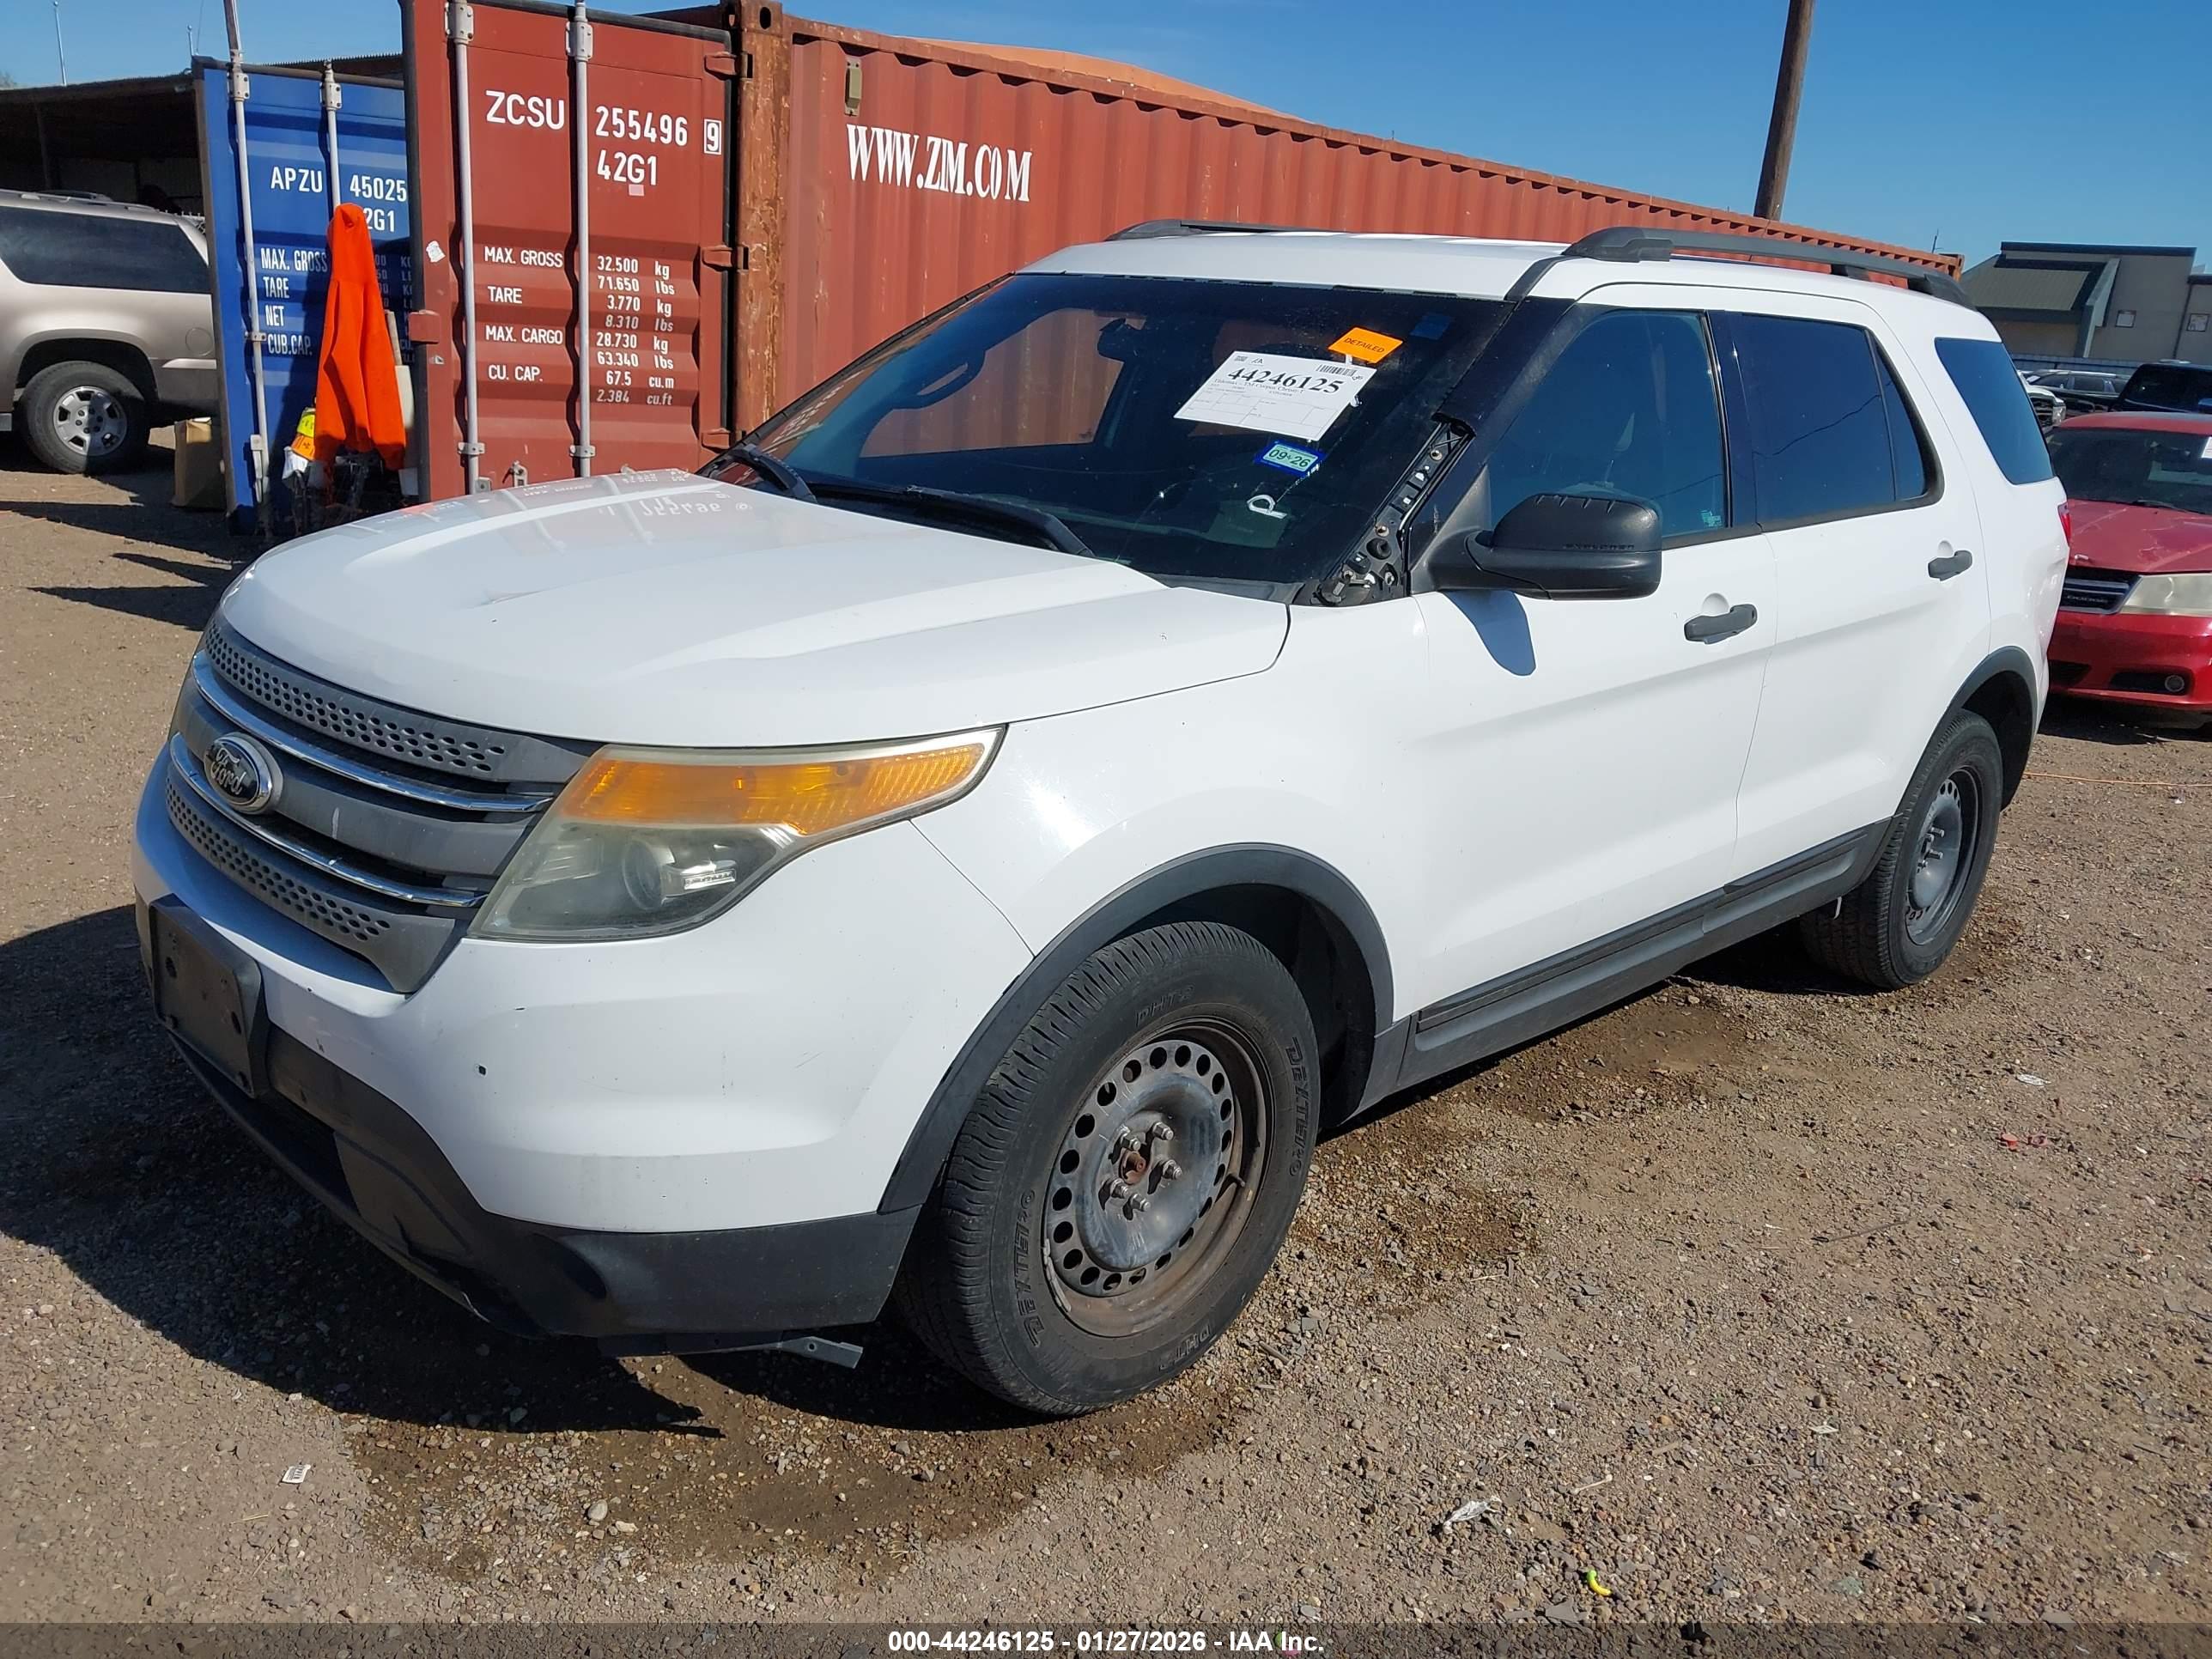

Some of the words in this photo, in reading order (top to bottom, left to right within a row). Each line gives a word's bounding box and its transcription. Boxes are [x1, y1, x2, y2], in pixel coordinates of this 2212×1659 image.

[486, 90, 564, 130] ZCSU
[595, 106, 687, 147] 255496
[706, 122, 720, 153] 9
[597, 149, 657, 185] 42G1
[270, 166, 323, 193] APZU
[349, 174, 407, 202] 45025
[260, 247, 289, 270] MAX.
[294, 250, 328, 272] GROSS
[484, 246, 516, 264] MAX.
[520, 250, 563, 268] GROSS
[597, 255, 638, 273] 32.500
[654, 260, 670, 280] kg
[263, 276, 290, 299] TARE
[487, 286, 523, 304] TARE
[598, 275, 640, 292] 71.650
[655, 280, 675, 295] lbs
[264, 304, 284, 326] NET
[607, 295, 641, 311] 3.770
[657, 299, 672, 318] kg
[605, 314, 639, 329] 8.310
[654, 318, 674, 332] lbs
[485, 325, 516, 343] MAX.
[521, 328, 563, 344] CARGO
[596, 331, 637, 349] 28.730
[653, 336, 668, 354] kg
[1344, 337, 1385, 353] DETAILED
[597, 351, 639, 368] 63.340
[653, 355, 674, 369] lbs
[488, 365, 509, 380] CU.
[515, 366, 543, 382] CAP.
[605, 370, 631, 386] 67.5
[648, 376, 674, 389] cu.m
[1228, 367, 1345, 393] 44246125
[210, 747, 247, 795] Ford
